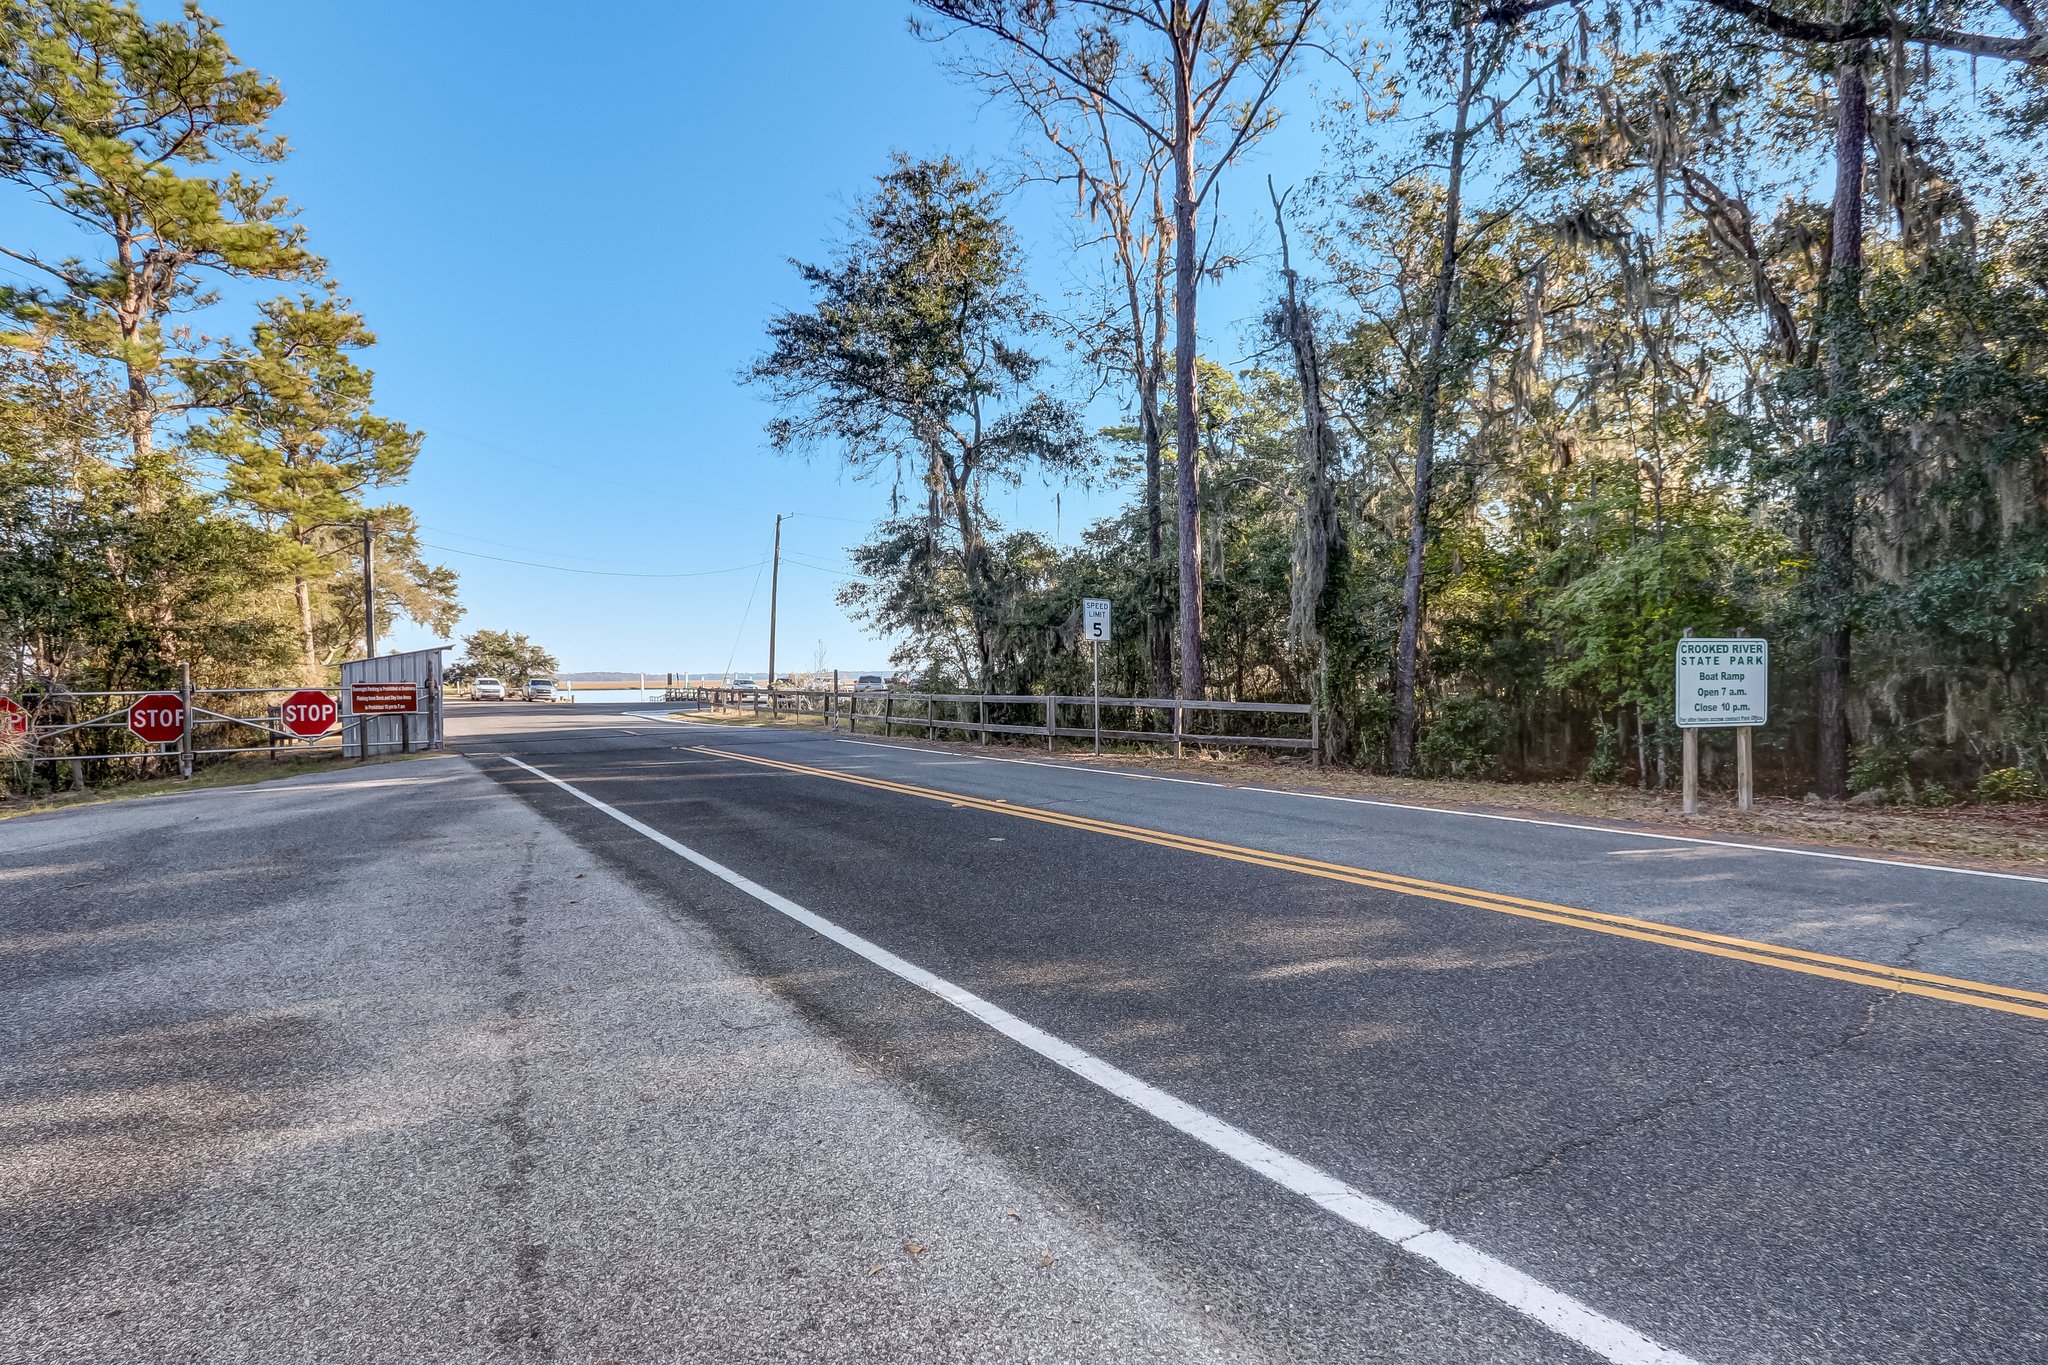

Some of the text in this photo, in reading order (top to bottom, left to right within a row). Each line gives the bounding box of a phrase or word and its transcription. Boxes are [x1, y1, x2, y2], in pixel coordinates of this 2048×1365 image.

[1094, 623, 1102, 637] 5
[1681, 645, 1763, 653] CROOKED RIVER
[1681, 656, 1763, 665] STATE PARK
[1699, 672, 1745, 682] Boat Ramp
[1697, 688, 1719, 698] Open
[1721, 688, 1727, 696] 7
[285, 704, 333, 722] STOP
[1694, 703, 1750, 713] Close 10 p.m.
